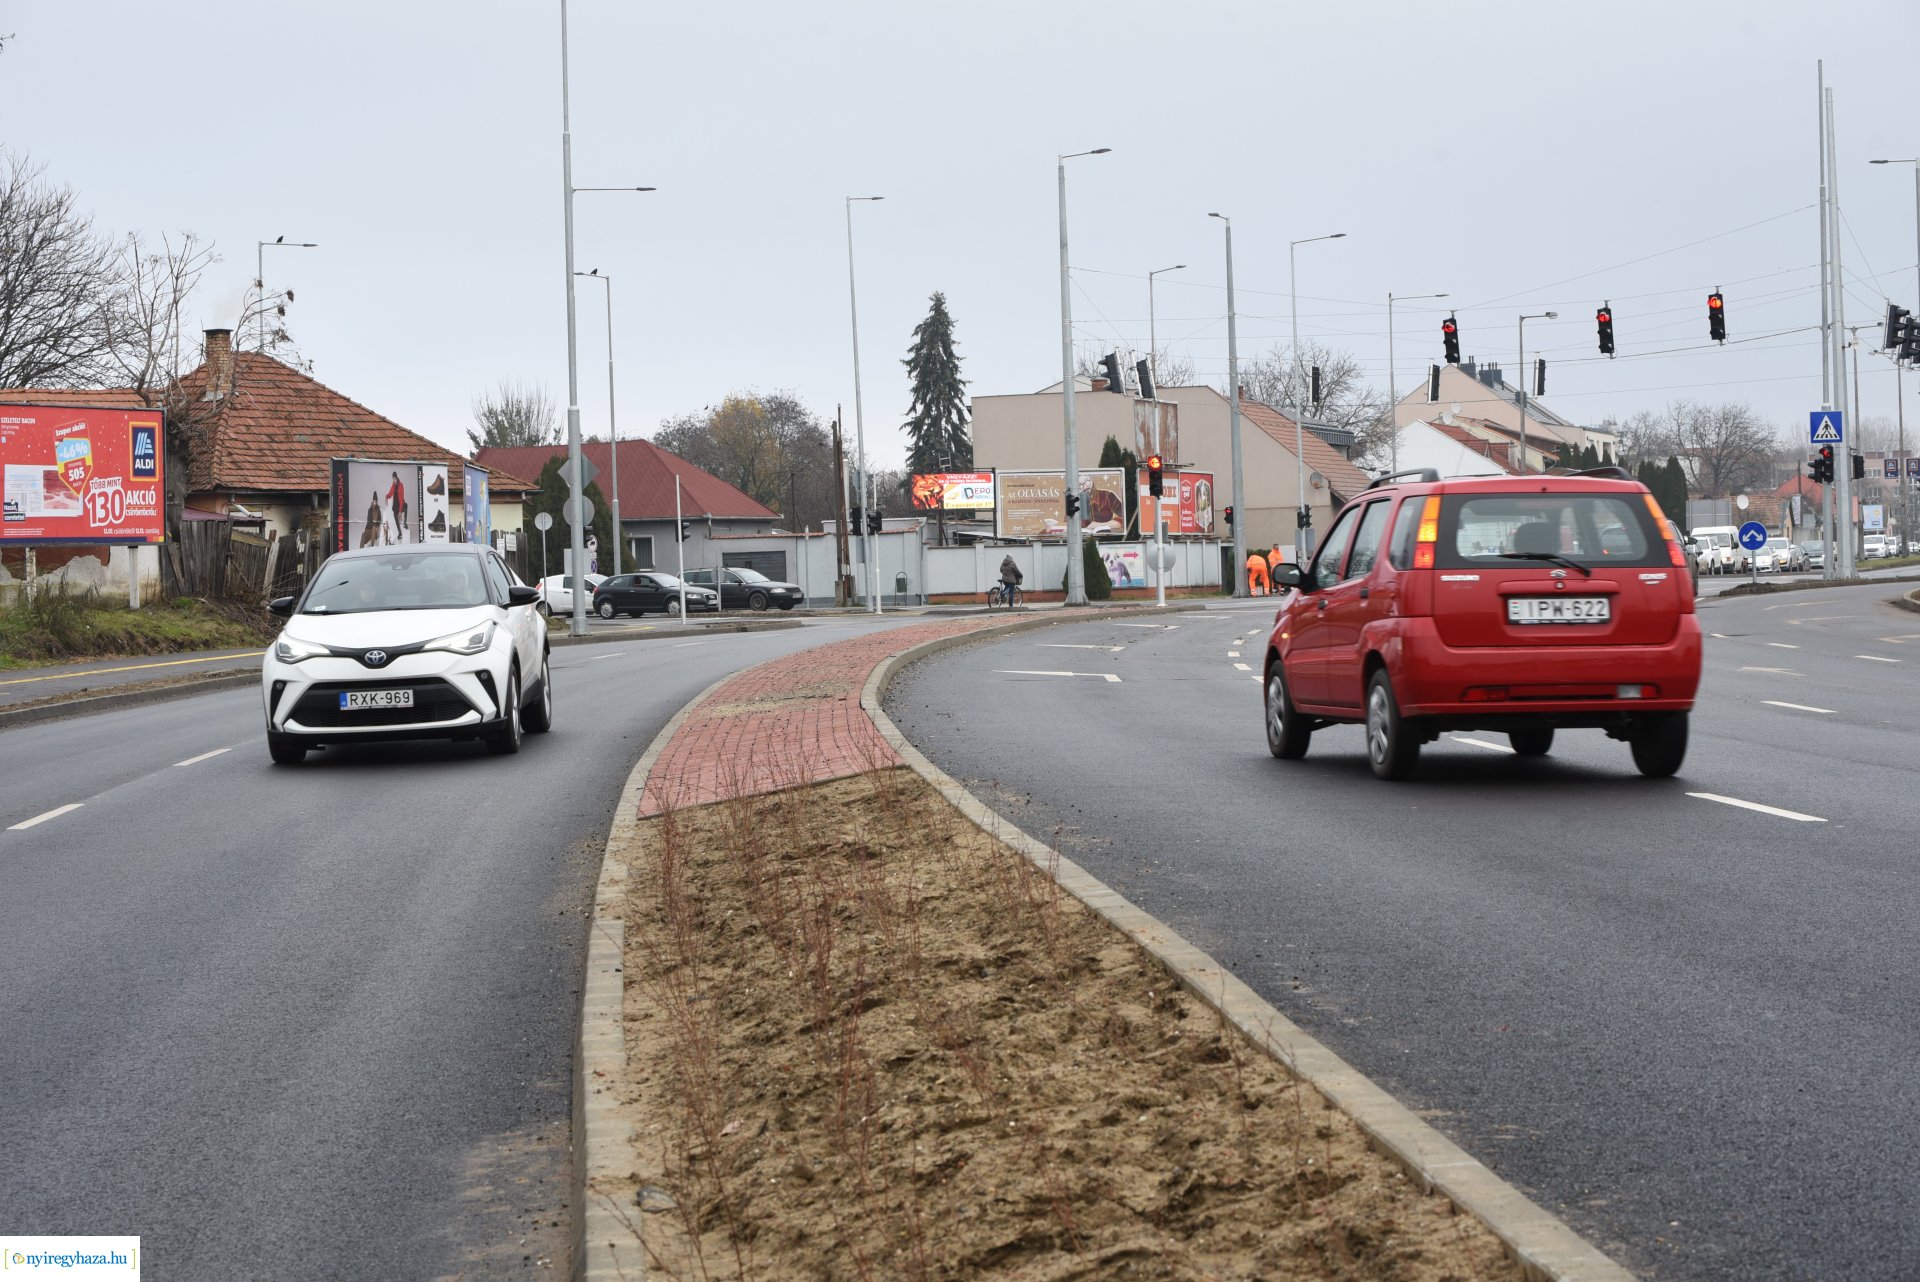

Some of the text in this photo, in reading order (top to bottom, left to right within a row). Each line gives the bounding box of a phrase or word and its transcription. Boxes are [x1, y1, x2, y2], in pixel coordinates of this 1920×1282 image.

[135, 459, 154, 469] ALDI
[68, 466, 84, 482] 505
[91, 478, 106, 490] TÖBB
[107, 479, 120, 488] MINT
[126, 485, 156, 505] AKCIÓ
[1018, 487, 1060, 498] OLVASÁS
[86, 489, 125, 525] 130
[1528, 600, 1605, 617] IPW-622
[350, 692, 410, 706] RXK-969
